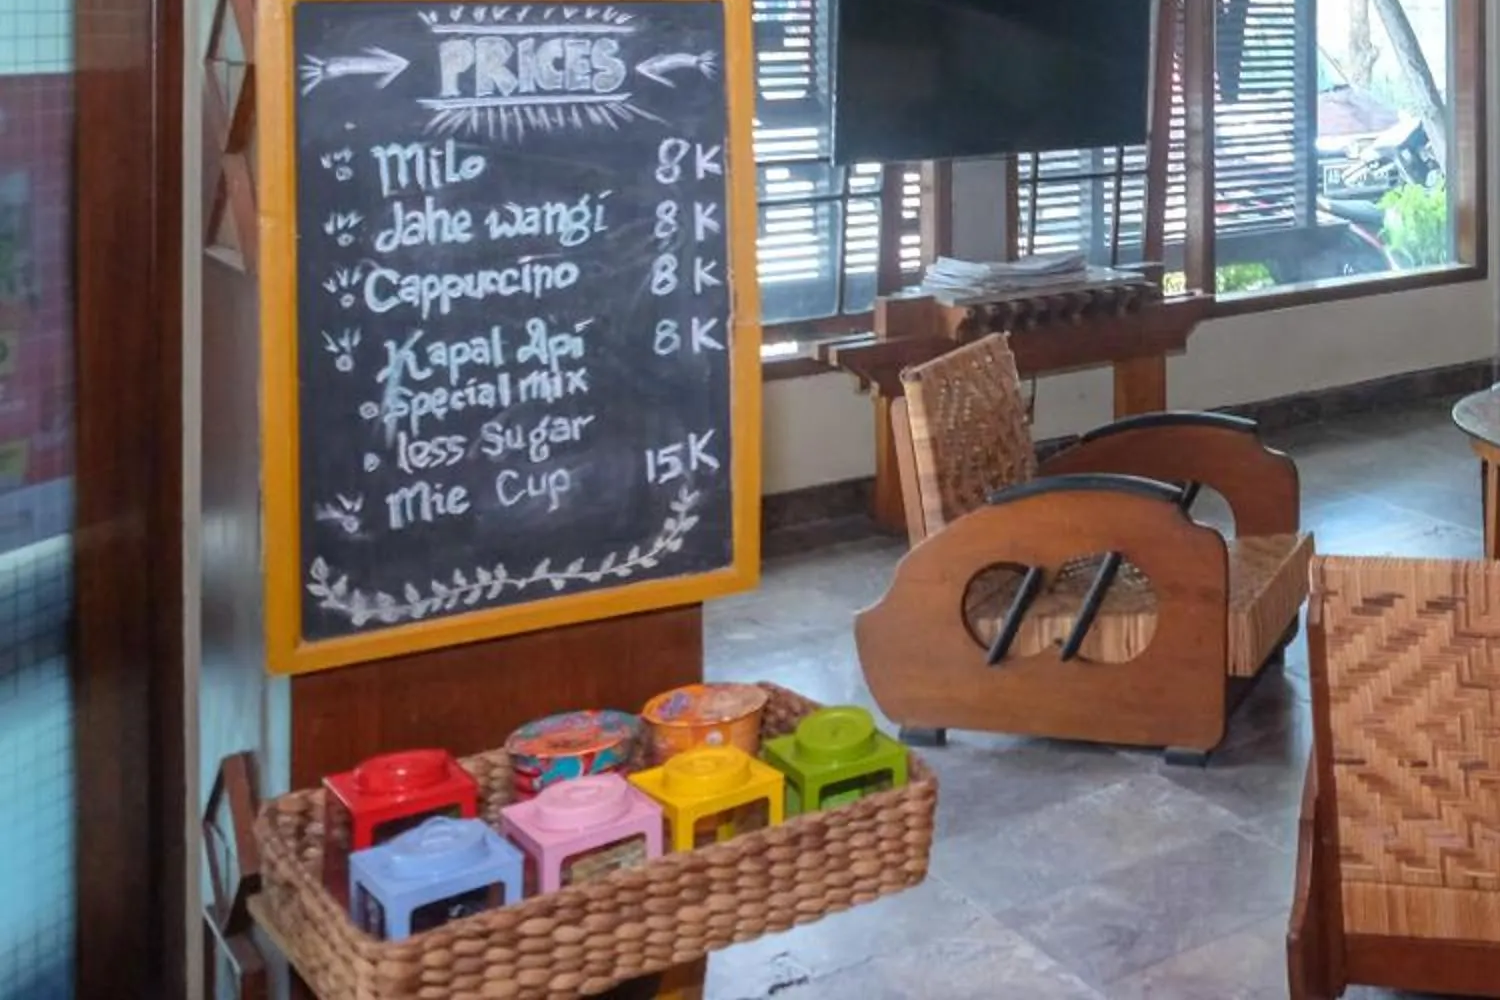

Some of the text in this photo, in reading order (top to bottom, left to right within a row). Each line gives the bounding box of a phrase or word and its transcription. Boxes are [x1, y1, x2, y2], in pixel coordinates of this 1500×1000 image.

[438, 36, 628, 98] PRICES
[374, 196, 475, 253] Jahe
[363, 261, 580, 320] Cappuccino
[376, 328, 505, 386] Kapal
[495, 467, 573, 514] Cup
